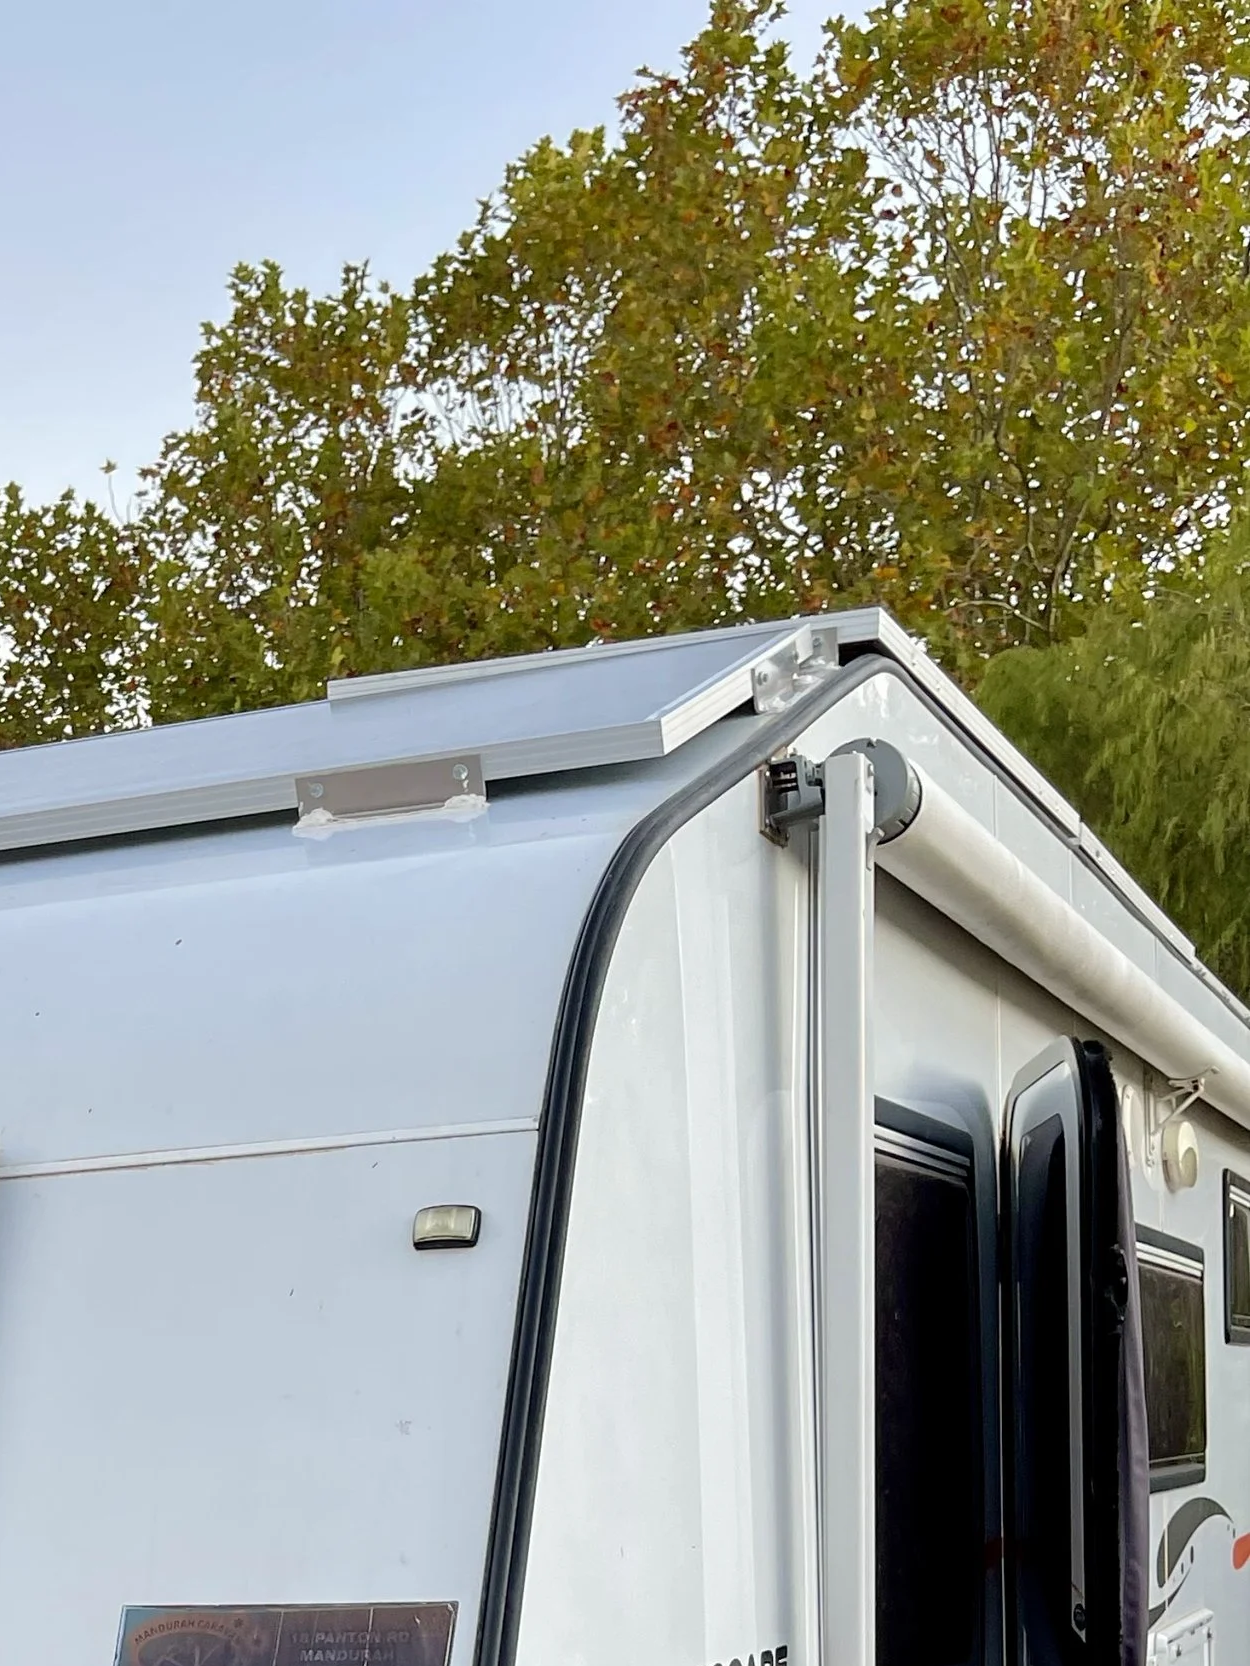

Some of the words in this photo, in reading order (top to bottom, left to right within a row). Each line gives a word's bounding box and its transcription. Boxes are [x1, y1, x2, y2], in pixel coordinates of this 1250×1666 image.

[134, 1618, 196, 1645] MANDURAH
[315, 1631, 381, 1645] PANTON
[386, 1631, 411, 1643] RD
[300, 1649, 394, 1662] MANDURAH
